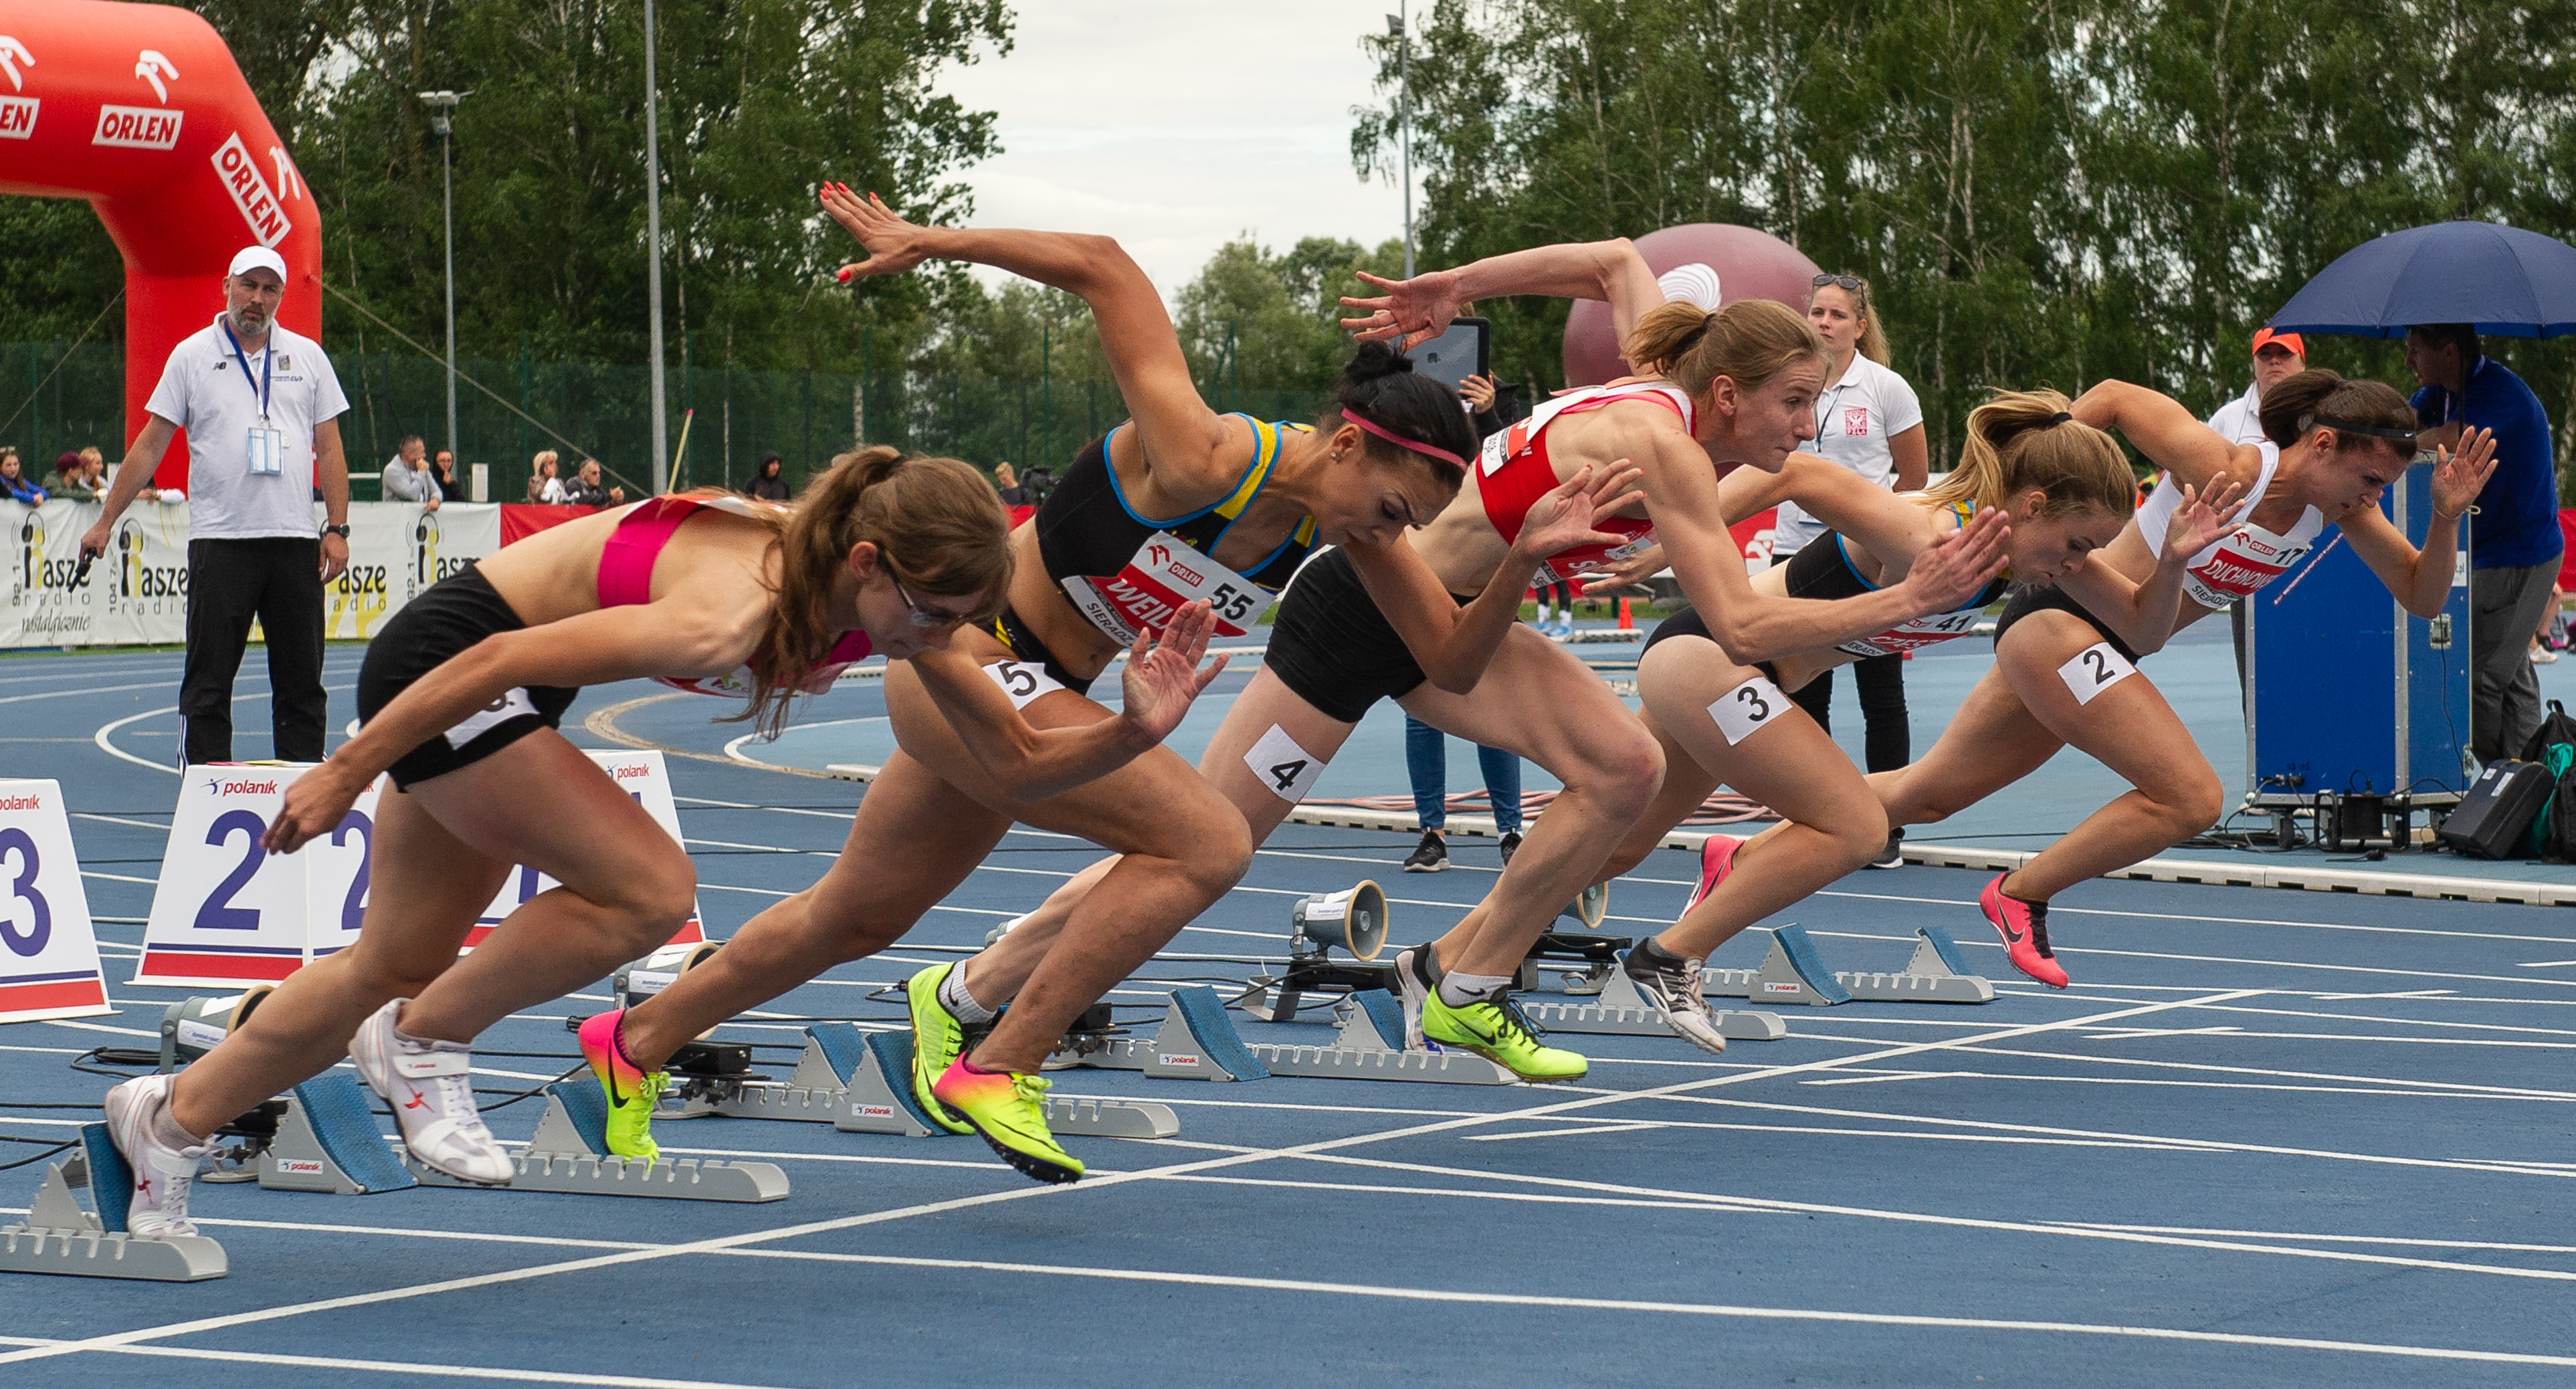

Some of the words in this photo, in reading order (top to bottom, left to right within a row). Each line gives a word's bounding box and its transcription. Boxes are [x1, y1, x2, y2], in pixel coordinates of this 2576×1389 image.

[102, 112, 177, 143] ORLEN
[221, 146, 284, 242] ORLEN
[2250, 542, 2274, 556] ORLEN
[1171, 562, 1201, 585] ORLEN
[333, 597, 387, 612] adio
[1107, 577, 1175, 630] WEIL
[1208, 582, 1256, 621] 55
[1086, 602, 1134, 643] SIERADZ
[1935, 615, 1972, 632] 41
[997, 661, 1038, 697] 5
[2083, 649, 2116, 686] 2
[1737, 686, 1770, 722] 3
[223, 780, 278, 796] polanik
[617, 764, 650, 781] polanik
[1270, 760, 1308, 792] 4
[193, 809, 268, 931] 2
[0, 828, 52, 957] 3
